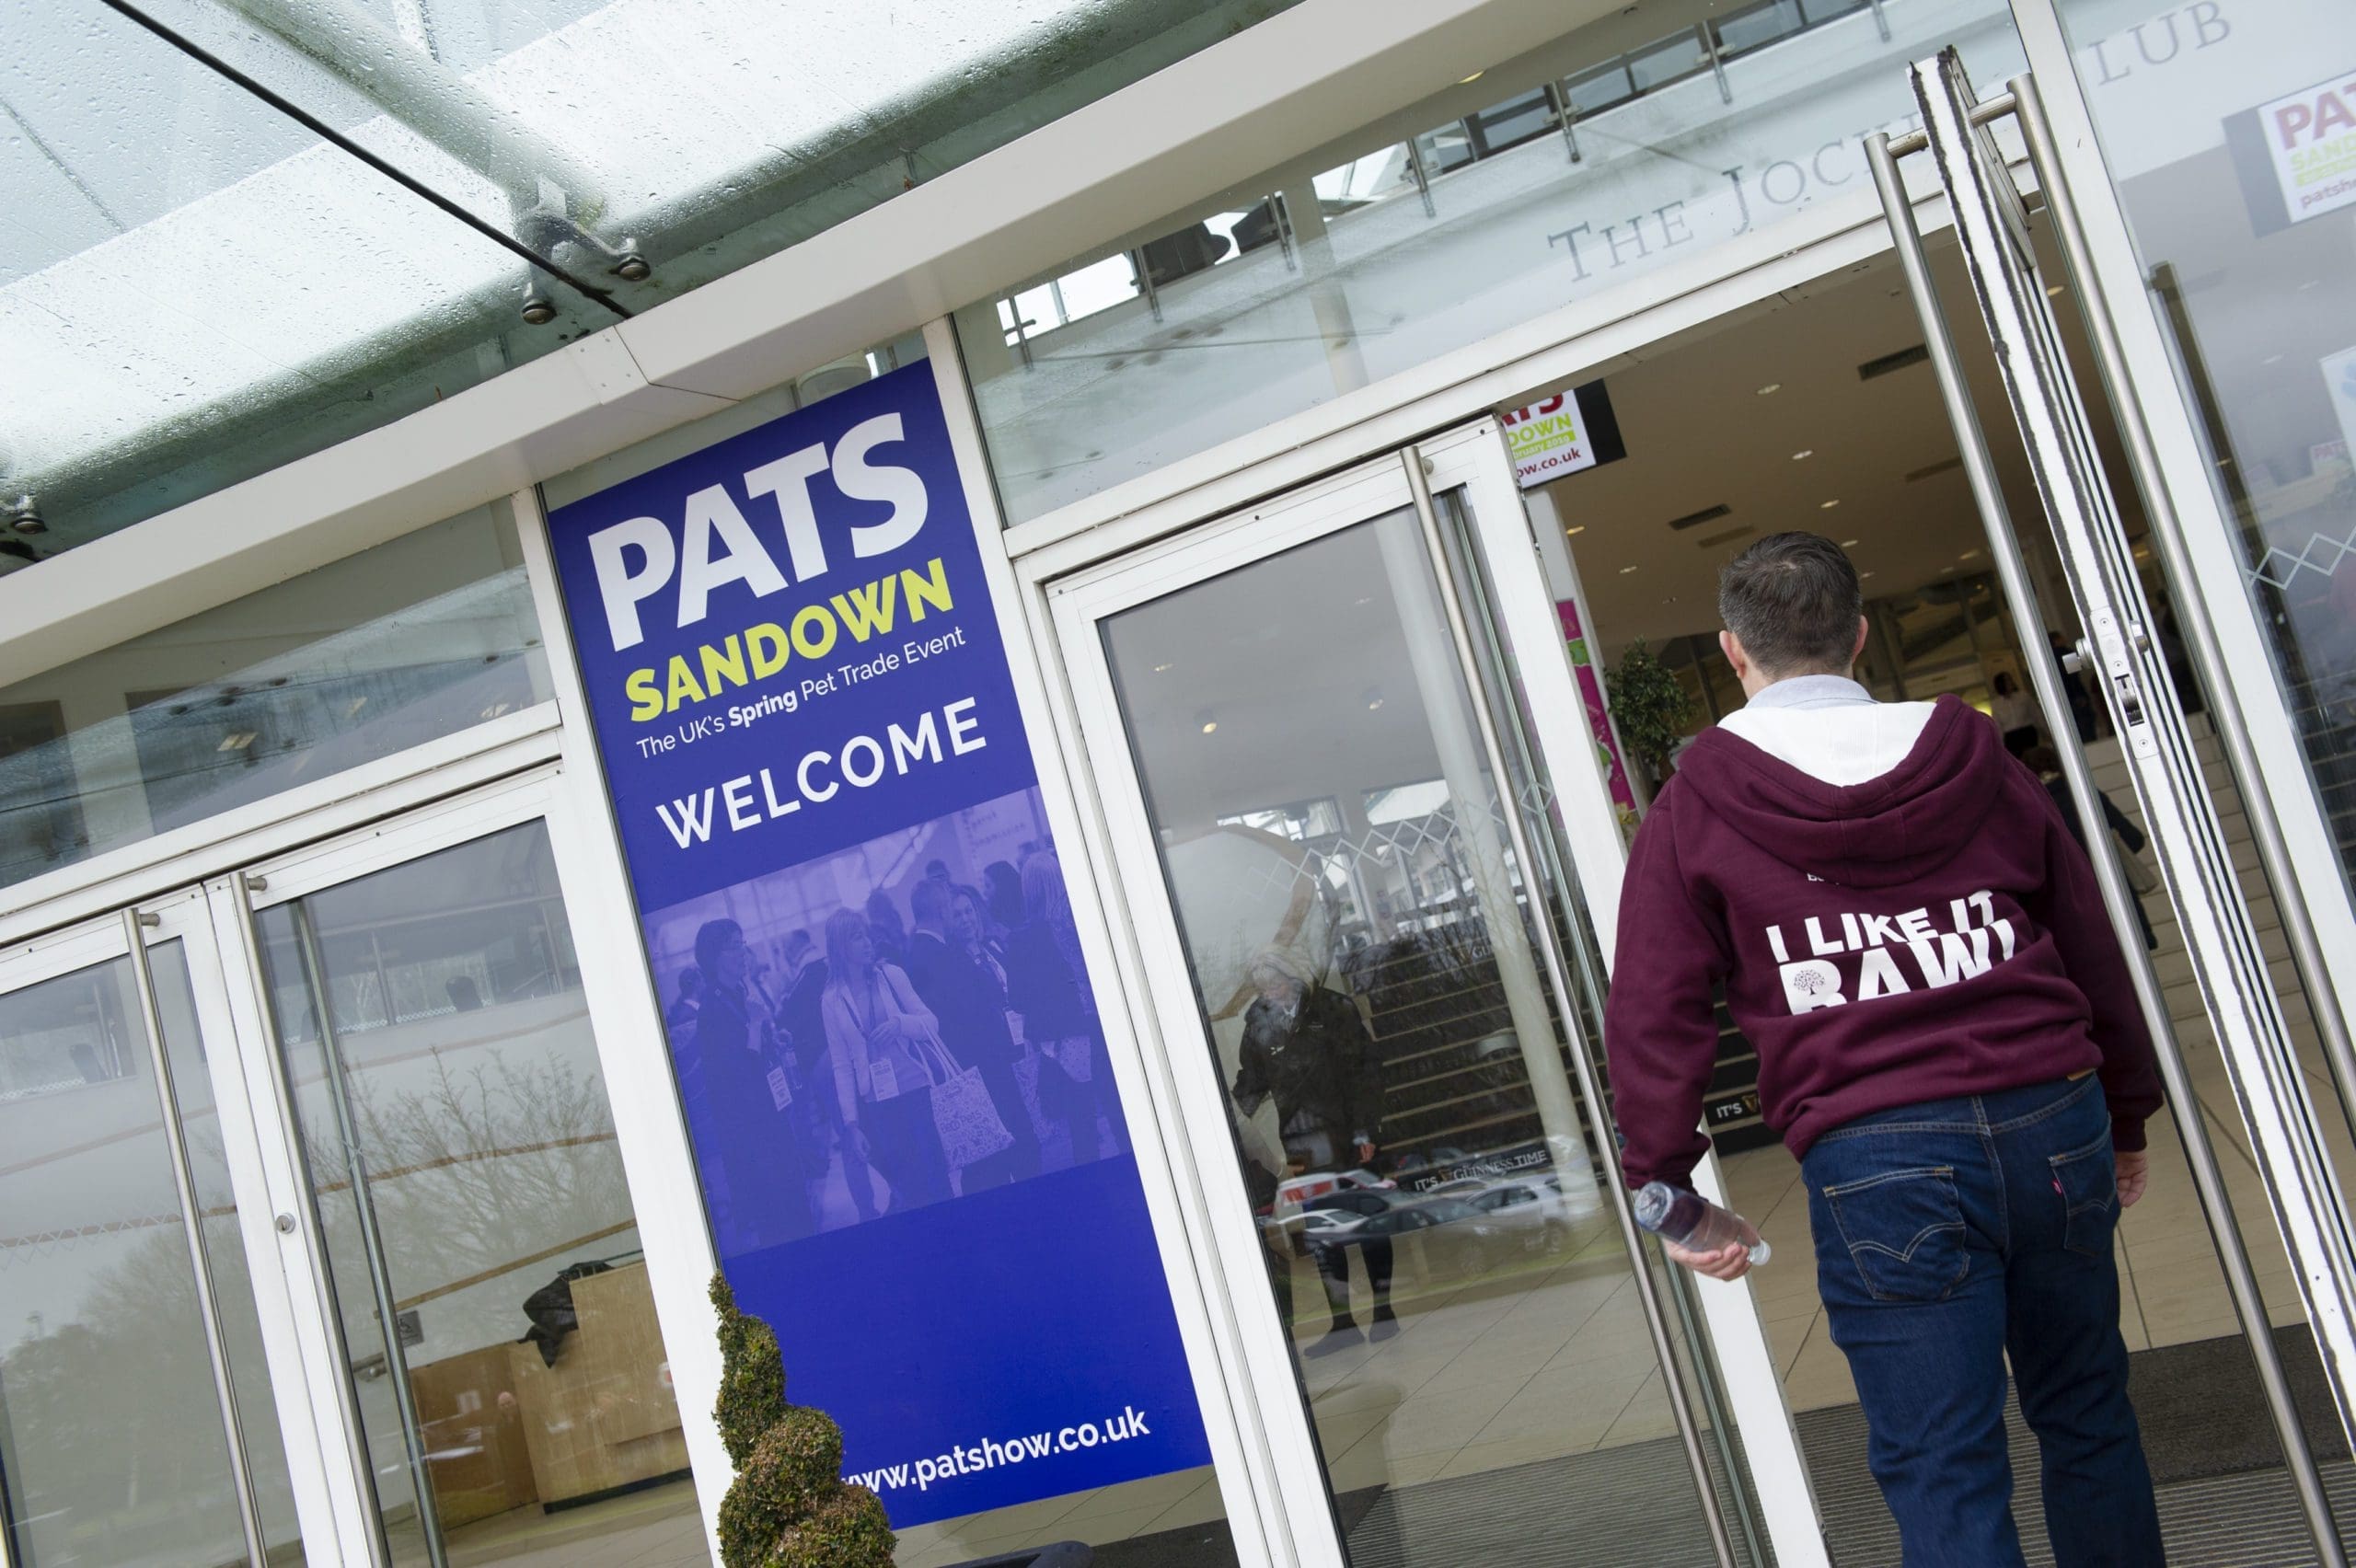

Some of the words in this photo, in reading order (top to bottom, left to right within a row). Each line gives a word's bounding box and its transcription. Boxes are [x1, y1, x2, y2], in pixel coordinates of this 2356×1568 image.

[1548, 200, 1694, 282] THE
[587, 411, 929, 652] PATS
[625, 557, 954, 722] SANDOWN
[636, 735, 676, 760] The
[678, 714, 726, 744] UK's
[727, 688, 799, 728] Spring
[801, 673, 838, 702] Pet
[838, 652, 900, 687] Trade
[906, 626, 966, 664] Event
[655, 697, 987, 849] WELCOME
[1766, 925, 1790, 963] I
[1804, 907, 1939, 956] LIKE
[1949, 889, 1995, 933] IT
[1715, 1102, 1744, 1119] IT'S
[1415, 1176, 1439, 1192] IT'S
[1453, 1159, 1514, 1181] GUINNESS
[1514, 1149, 1548, 1167] TIME
[839, 1405, 1150, 1493] ww.patshow.co.uk
